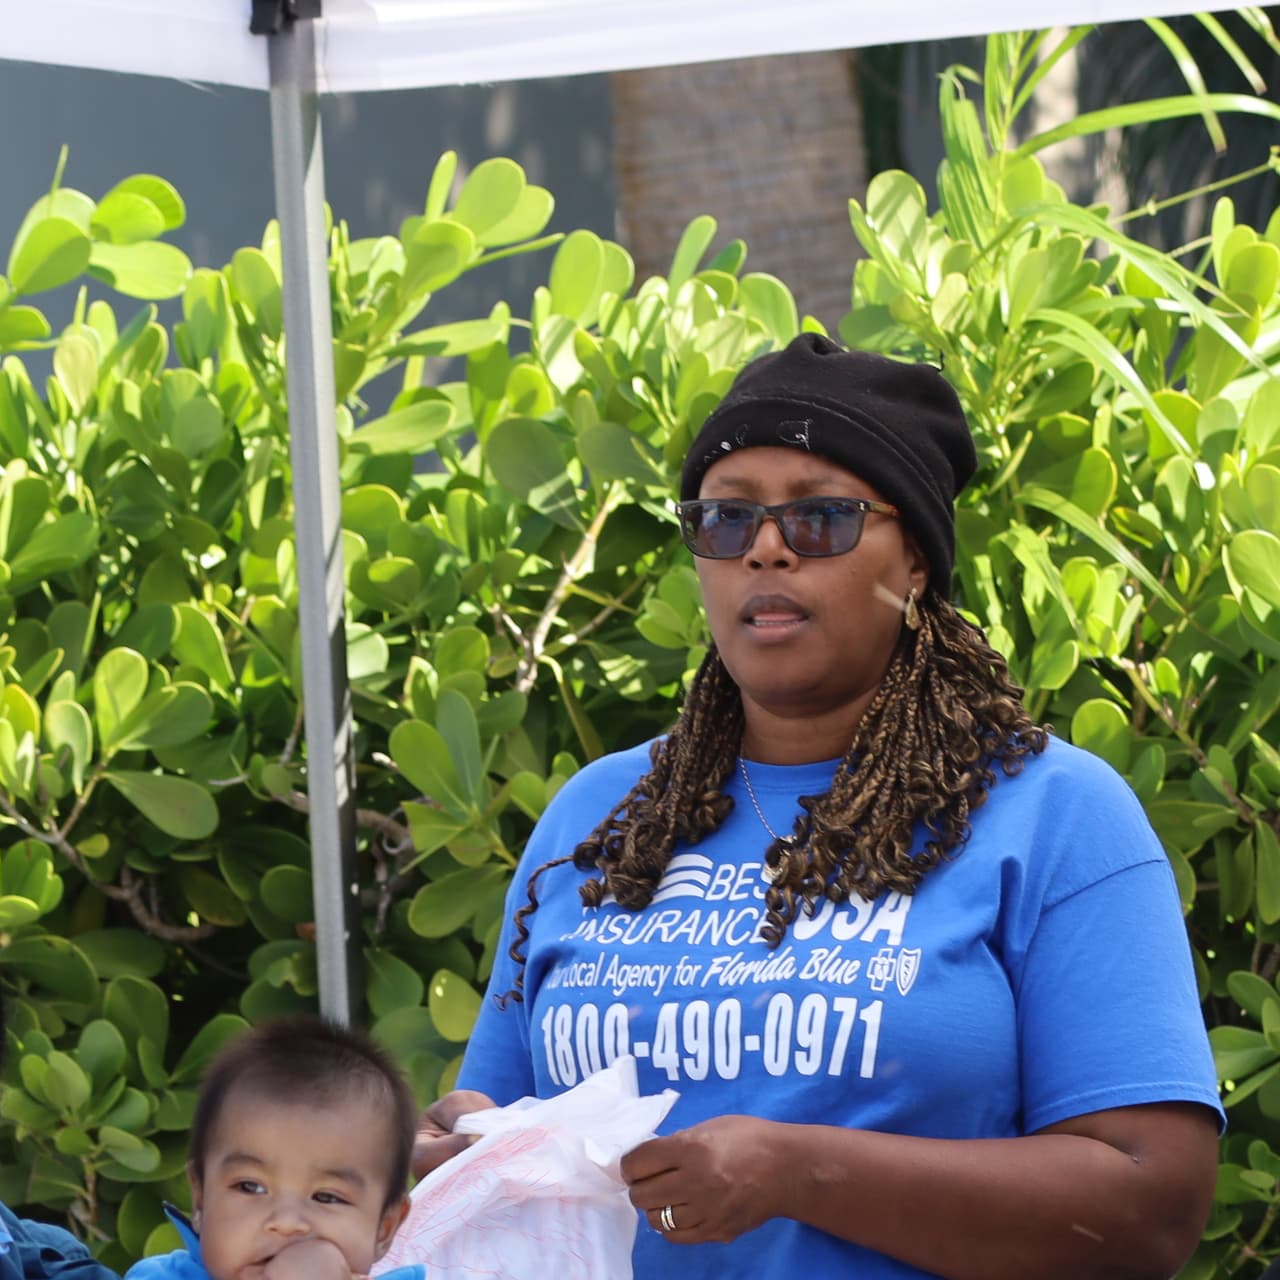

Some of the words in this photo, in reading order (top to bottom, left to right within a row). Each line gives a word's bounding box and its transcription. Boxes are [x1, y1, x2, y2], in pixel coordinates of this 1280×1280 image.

[704, 862, 771, 901] BES
[792, 888, 913, 946] USA
[601, 953, 672, 997] Agency
[672, 955, 704, 987] for
[700, 946, 798, 988] Florida
[798, 945, 862, 985] Blue
[540, 992, 884, 1088] 1800-490-0971
